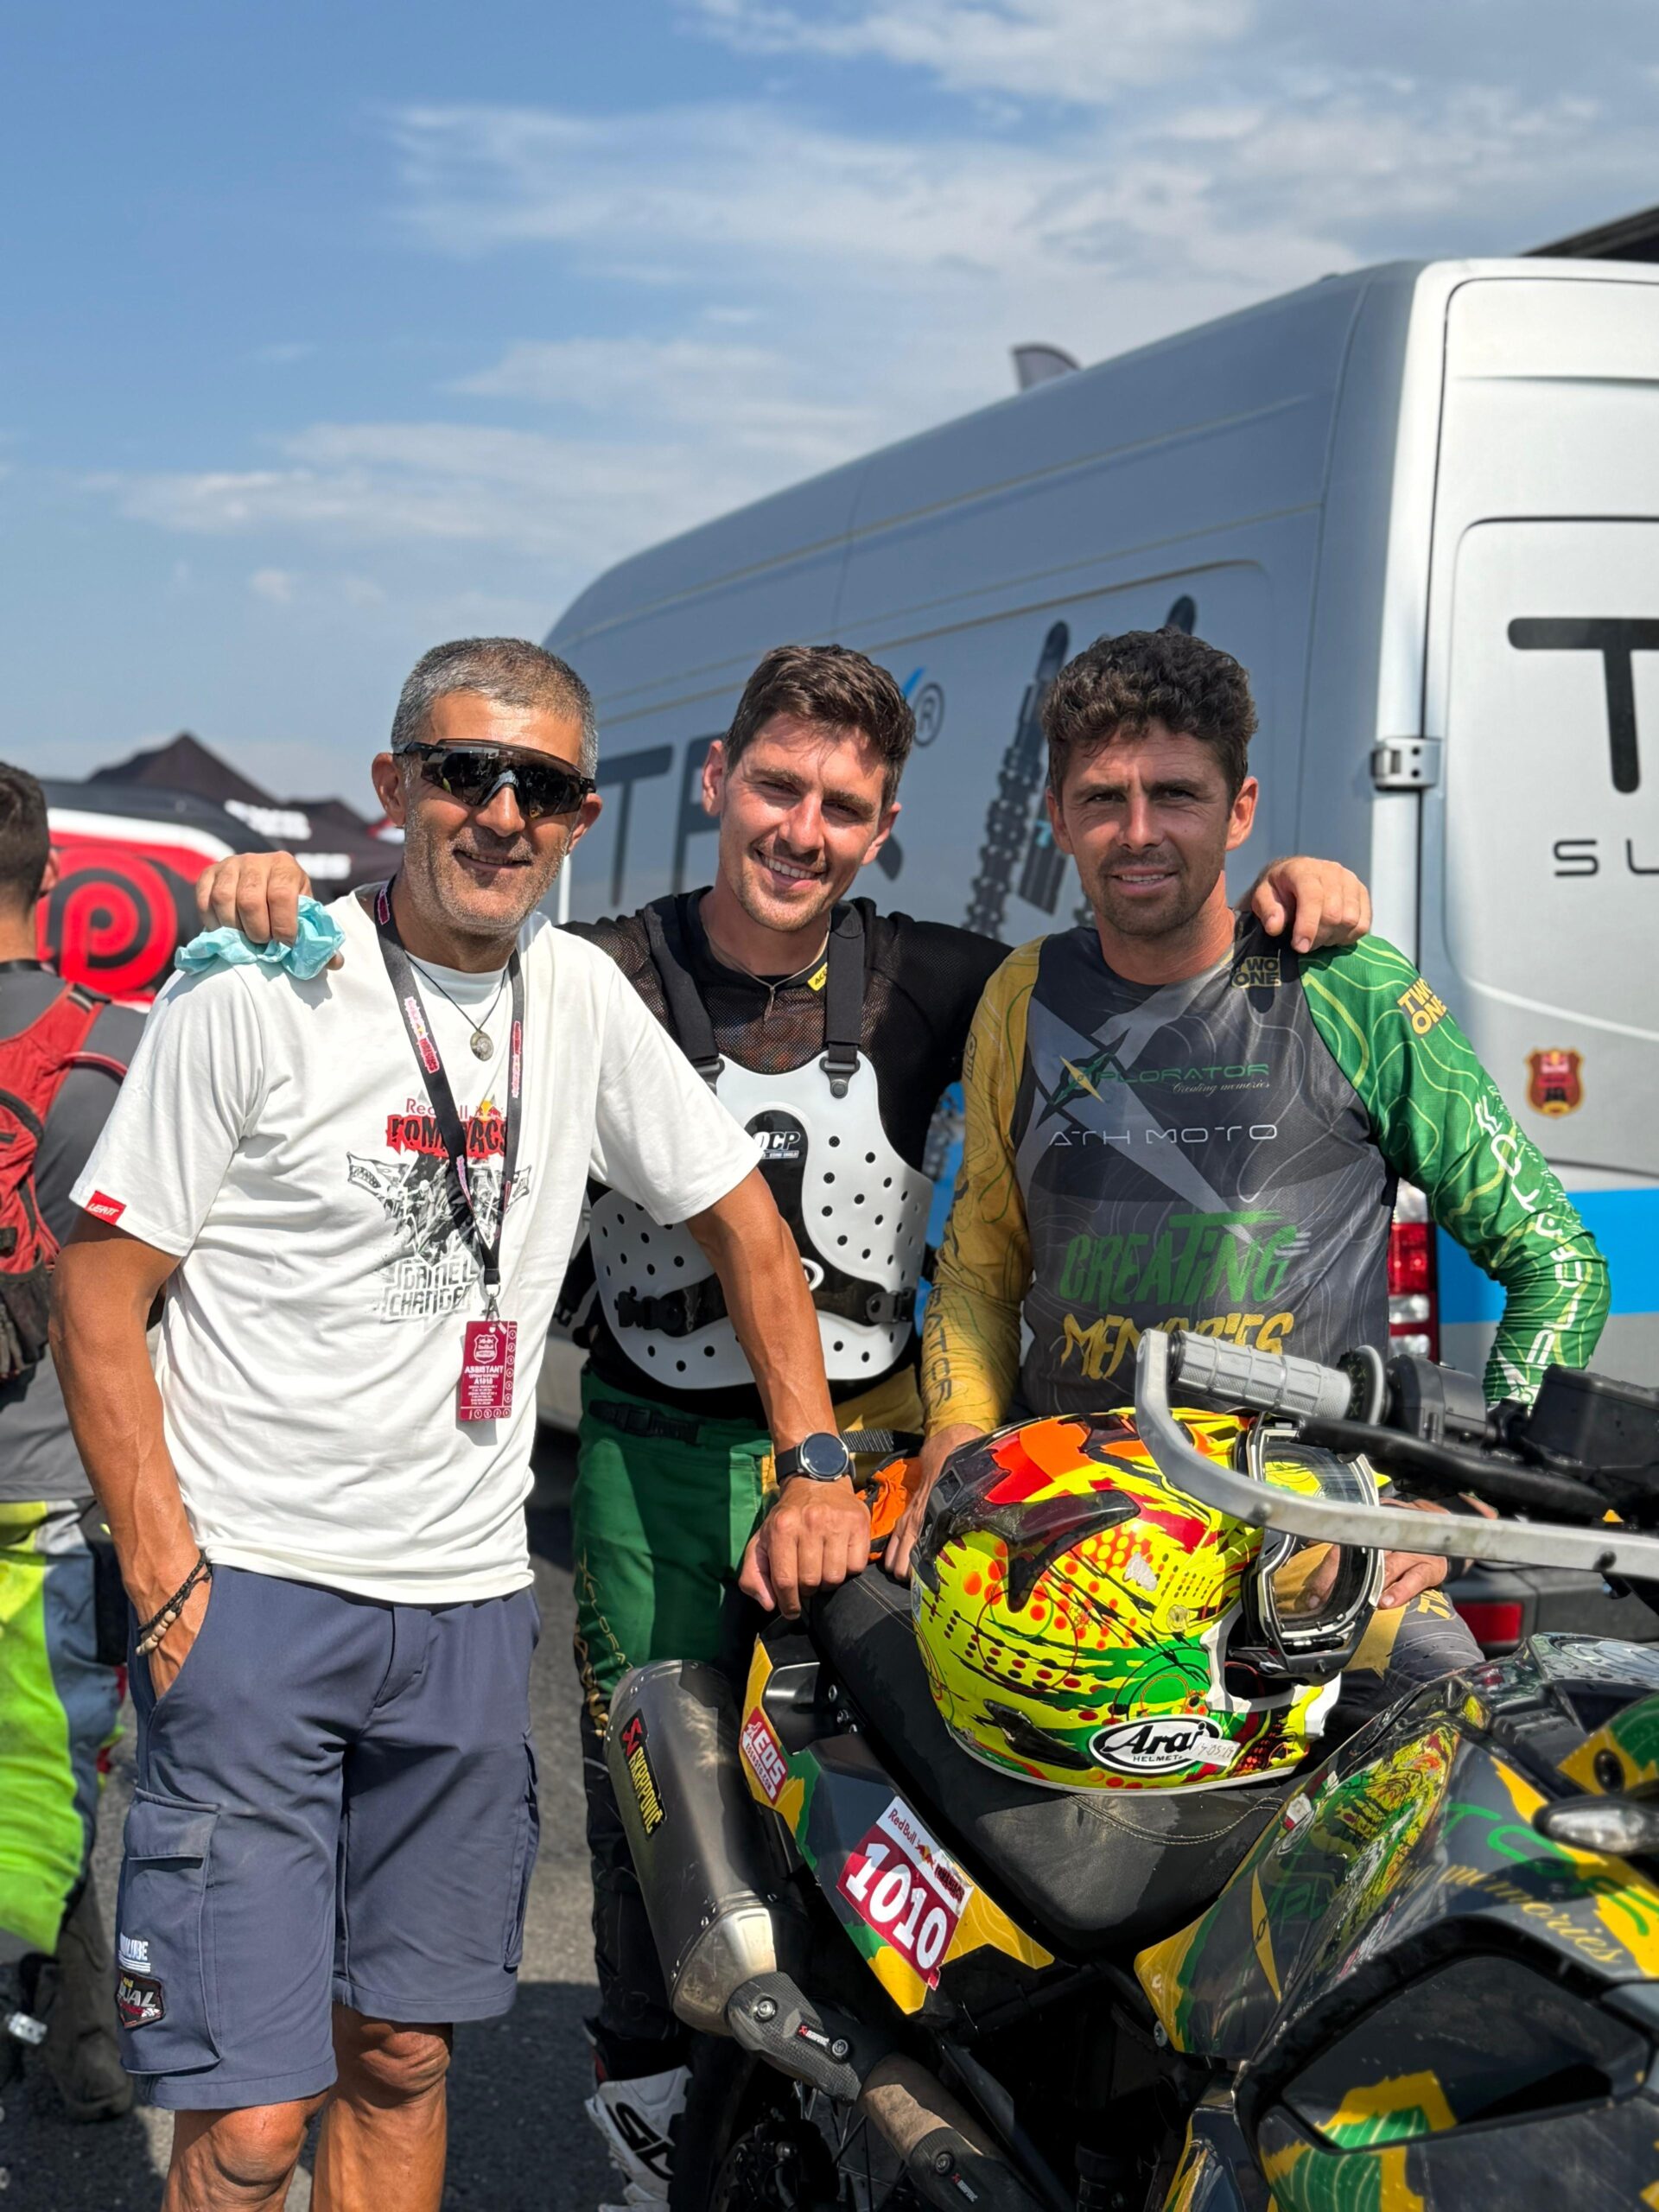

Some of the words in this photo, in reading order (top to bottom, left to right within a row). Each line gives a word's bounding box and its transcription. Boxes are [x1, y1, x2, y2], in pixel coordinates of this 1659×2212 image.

[1235, 971, 1280, 987] ONE
[1396, 977, 1433, 1015] TW
[1172, 1083, 1217, 1098] Creating
[1220, 1078, 1270, 1091] memories
[1048, 1129, 1130, 1147] ATH
[1146, 1124, 1278, 1144] MOTO
[845, 1842, 948, 1970] 1010
